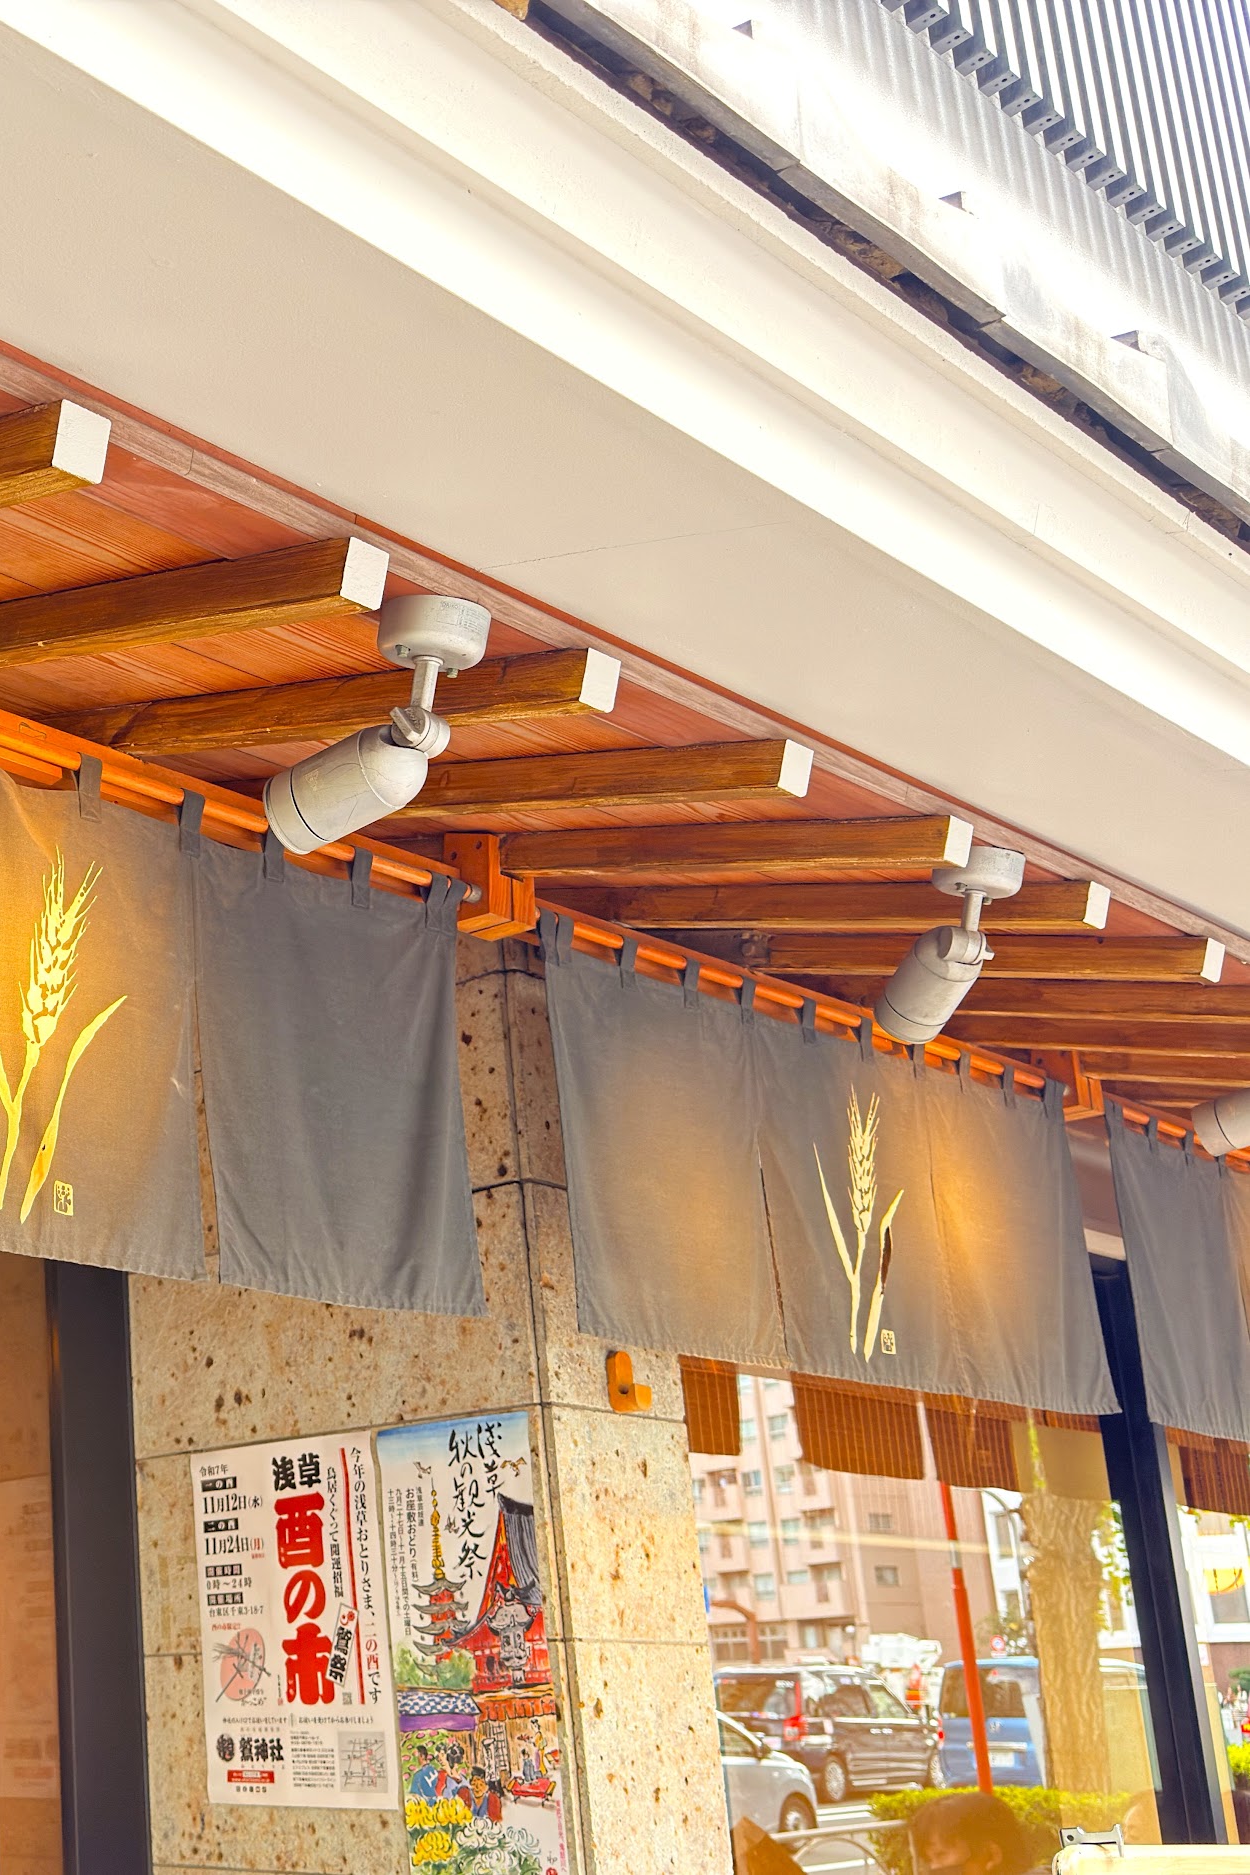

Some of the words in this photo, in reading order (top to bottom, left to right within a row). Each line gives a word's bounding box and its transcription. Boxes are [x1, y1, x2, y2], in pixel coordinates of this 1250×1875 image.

[199, 1464, 228, 1477] 令和7年
[271, 1452, 321, 1492] 浅草
[476, 1421, 505, 1498] 浅草
[203, 1493, 263, 1514] 11月12日(水)
[448, 1429, 489, 1581] 秋の観光祭
[204, 1534, 264, 1555] 11月24日(月)
[326, 1466, 344, 1598] 鳥居くぐって開運招福
[274, 1491, 335, 1706] 酉の市
[239, 1736, 285, 1762] 鷲神社
